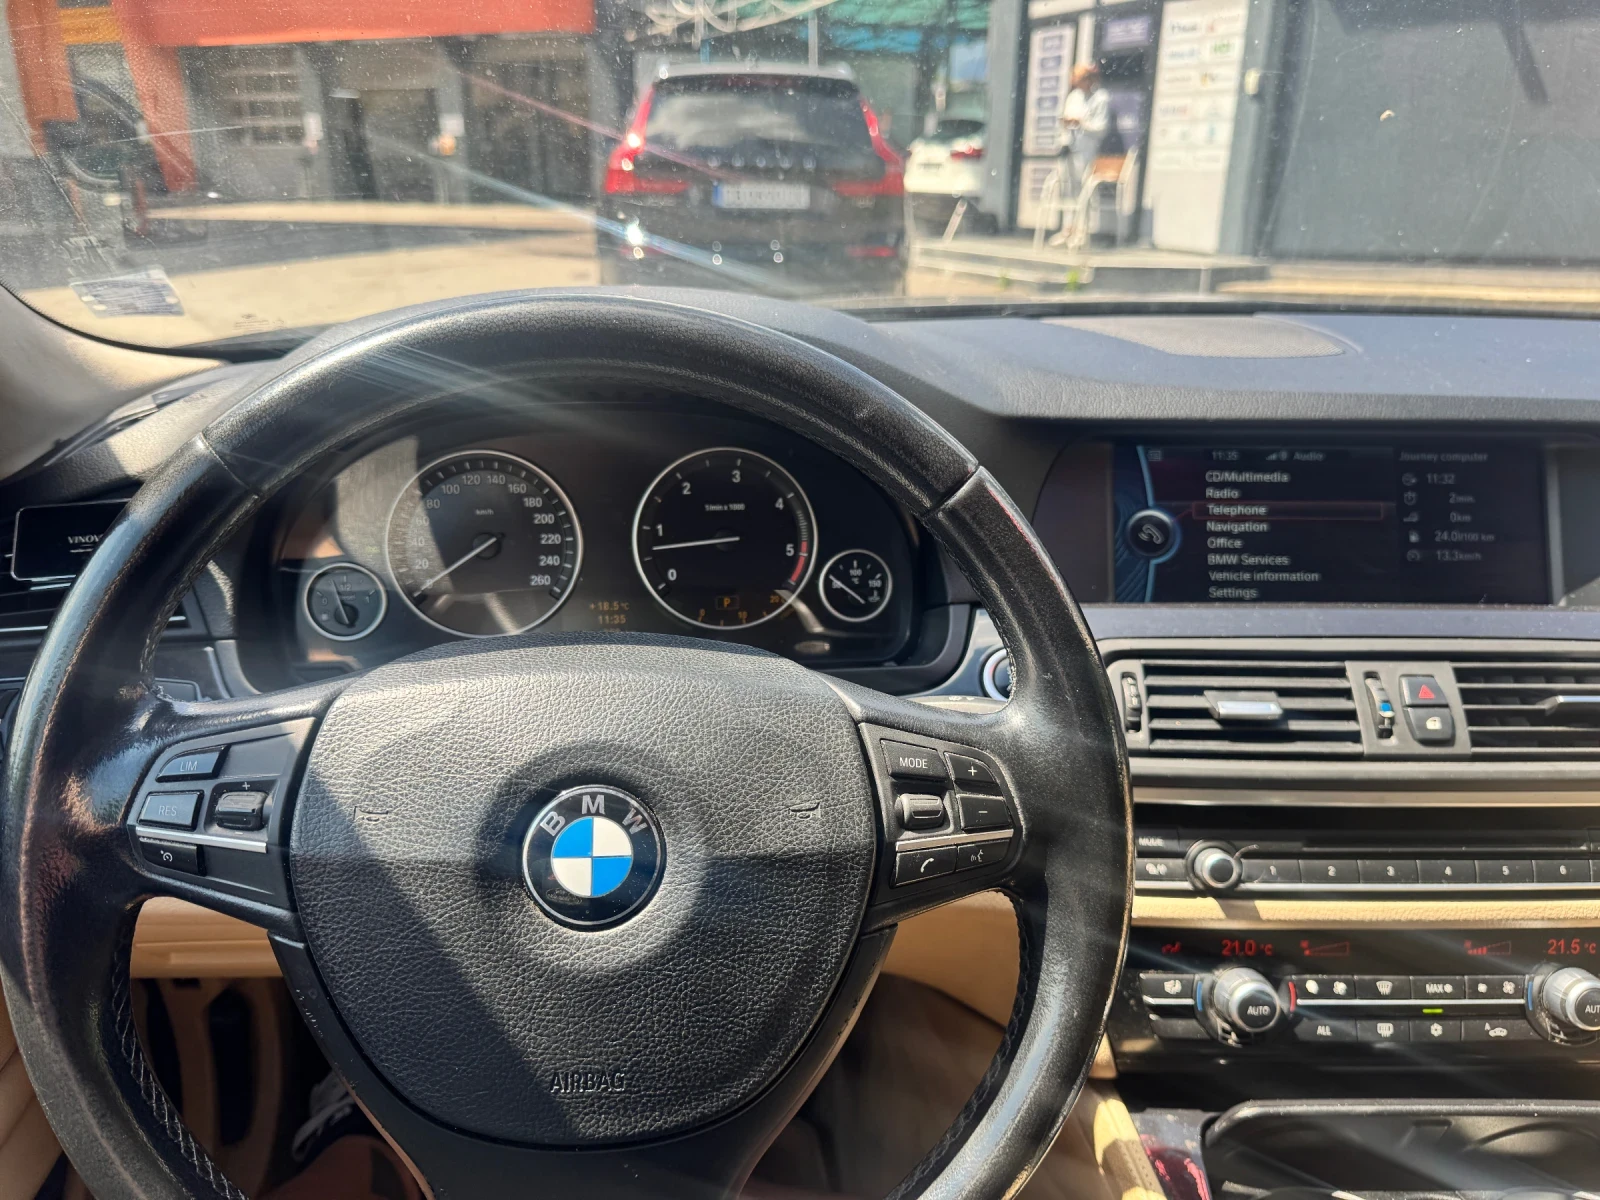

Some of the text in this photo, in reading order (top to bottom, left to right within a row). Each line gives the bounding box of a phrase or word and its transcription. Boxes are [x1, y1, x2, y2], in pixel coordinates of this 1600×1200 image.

[1293, 451, 1324, 461] Audio
[1400, 452, 1488, 463] Journey computer
[461, 475, 481, 486] 120
[487, 475, 506, 486] 140
[731, 470, 741, 483] 3
[1205, 470, 1291, 483] CD/Multimedia
[441, 484, 460, 495] 100
[508, 483, 526, 494] 160
[682, 482, 692, 495] 2
[1206, 487, 1239, 499] Radio
[426, 497, 441, 509] 80
[523, 497, 543, 508] 180
[775, 498, 784, 510] 4
[1207, 504, 1267, 517] Telephone
[415, 516, 430, 526] 60
[533, 513, 555, 525] 200
[656, 524, 663, 537] 1
[1206, 521, 1268, 534] Navigation
[540, 534, 562, 545] 220
[1207, 537, 1242, 549] Office
[786, 544, 795, 557] 5
[415, 559, 429, 570] 20
[539, 555, 561, 567] 240
[1207, 553, 1290, 566] BMW Services
[530, 575, 551, 586] 260
[667, 569, 677, 581] 0
[1208, 570, 1320, 582] Vehicle information
[1208, 586, 1257, 600] Settings
[722, 597, 731, 608] P
[599, 614, 627, 625] 11:35
[180, 760, 199, 772] LIM
[899, 756, 929, 769] MODE
[158, 805, 177, 817] RES
[539, 794, 648, 837] BMW
[1269, 865, 1277, 876] 1
[1327, 865, 1336, 877] 2
[1386, 865, 1395, 877] 3
[1444, 866, 1452, 876] 4
[1502, 865, 1510, 876] 5
[1559, 864, 1567, 876] 6
[1221, 939, 1256, 956] 21.0
[1547, 938, 1580, 955] 21.5
[1425, 983, 1444, 994] MAX
[1247, 1004, 1271, 1017] AUTO
[1316, 1025, 1333, 1036] ALL
[550, 1071, 626, 1093] AIRBAG
